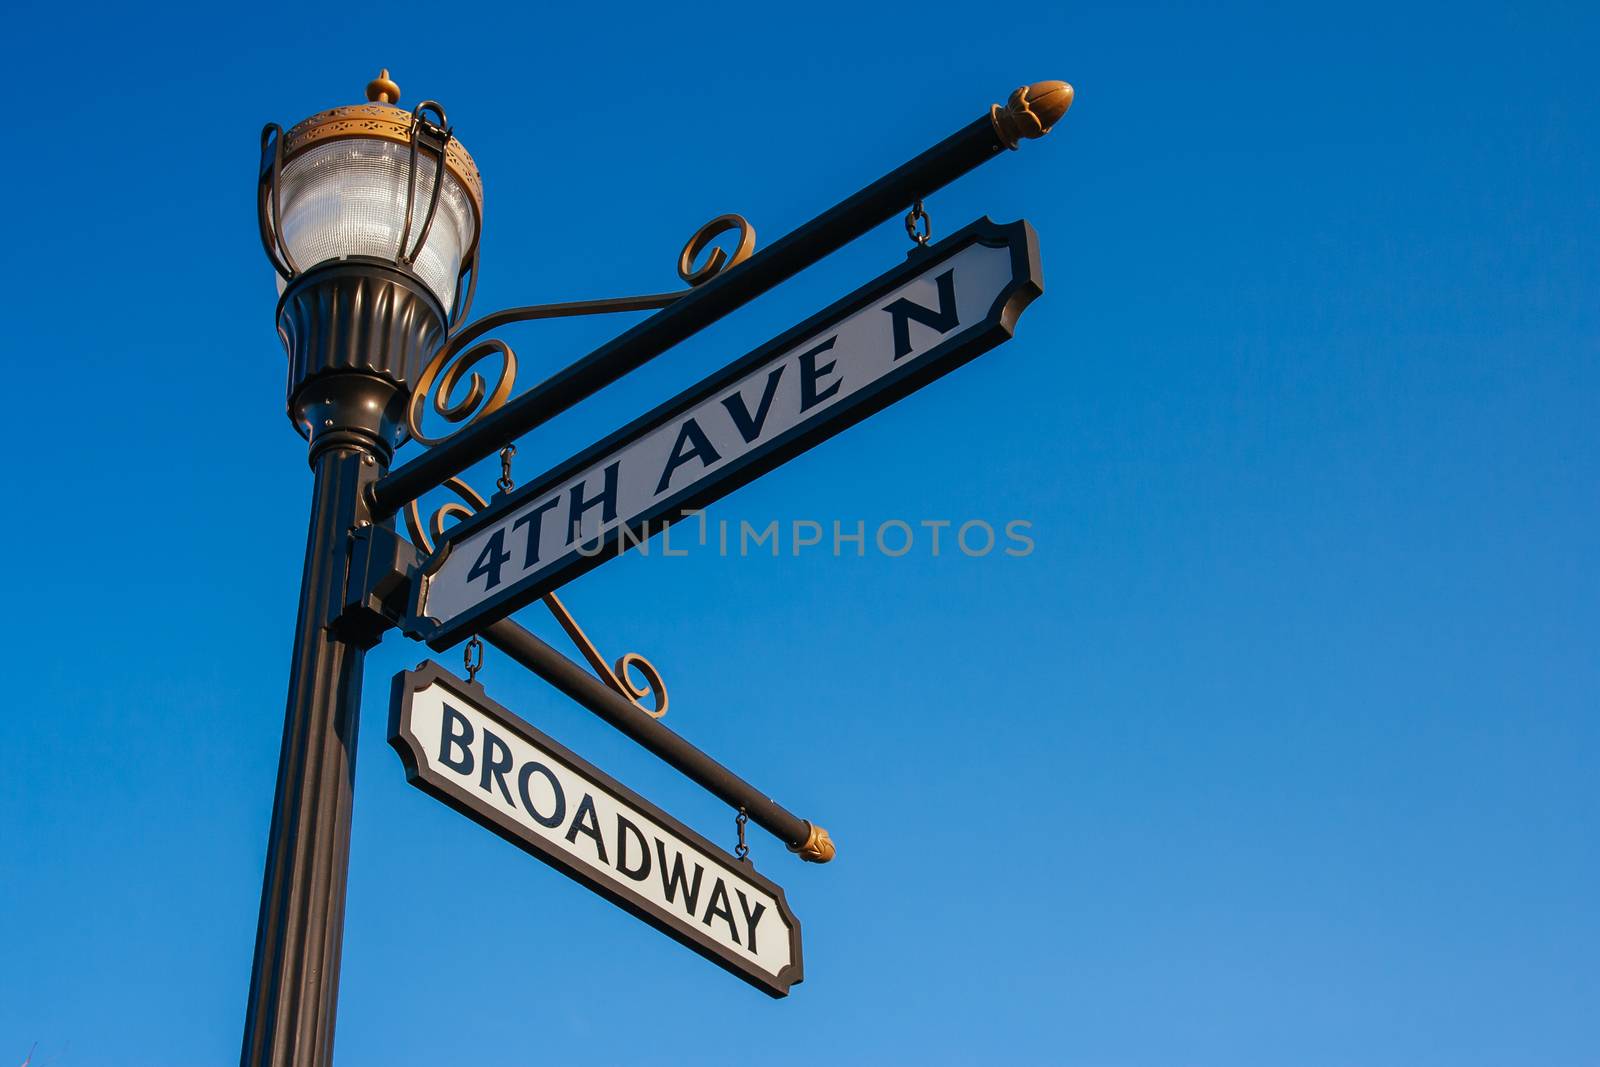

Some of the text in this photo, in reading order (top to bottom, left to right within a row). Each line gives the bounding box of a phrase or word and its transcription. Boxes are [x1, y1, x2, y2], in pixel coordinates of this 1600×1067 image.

[466, 268, 960, 592] 4TH AVE N
[438, 702, 766, 955] BROADWAY
